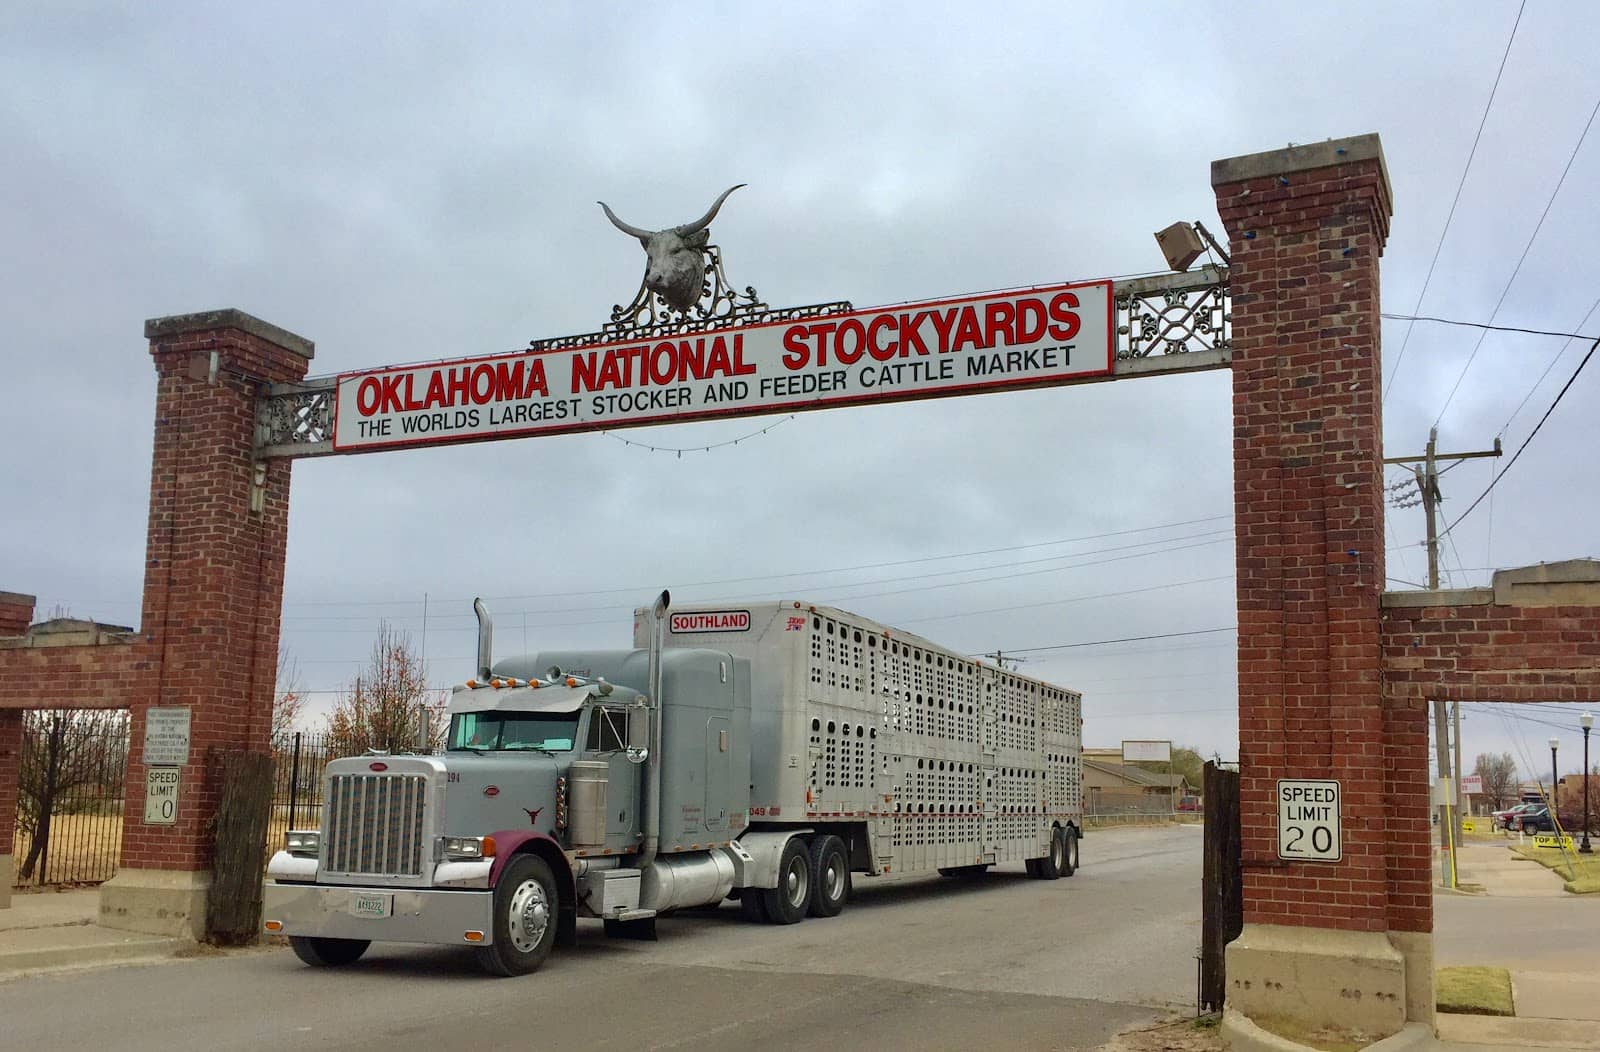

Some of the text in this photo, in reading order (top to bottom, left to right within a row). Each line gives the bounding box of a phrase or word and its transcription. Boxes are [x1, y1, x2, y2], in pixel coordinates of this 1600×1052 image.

[356, 292, 1081, 416] OKLAHOMA NATIONAL STOCKYARDS
[357, 345, 1076, 438] THE WORLDS LARGEST STOCKER AND FEEDER CATTLE MARKET
[673, 614, 748, 629] SOUTHLAND
[149, 772, 178, 783] SPEED
[150, 785, 174, 797] LIMIT
[1282, 787, 1336, 803] SPEED
[1287, 806, 1331, 821] LIMIT
[1285, 826, 1333, 853] 20
